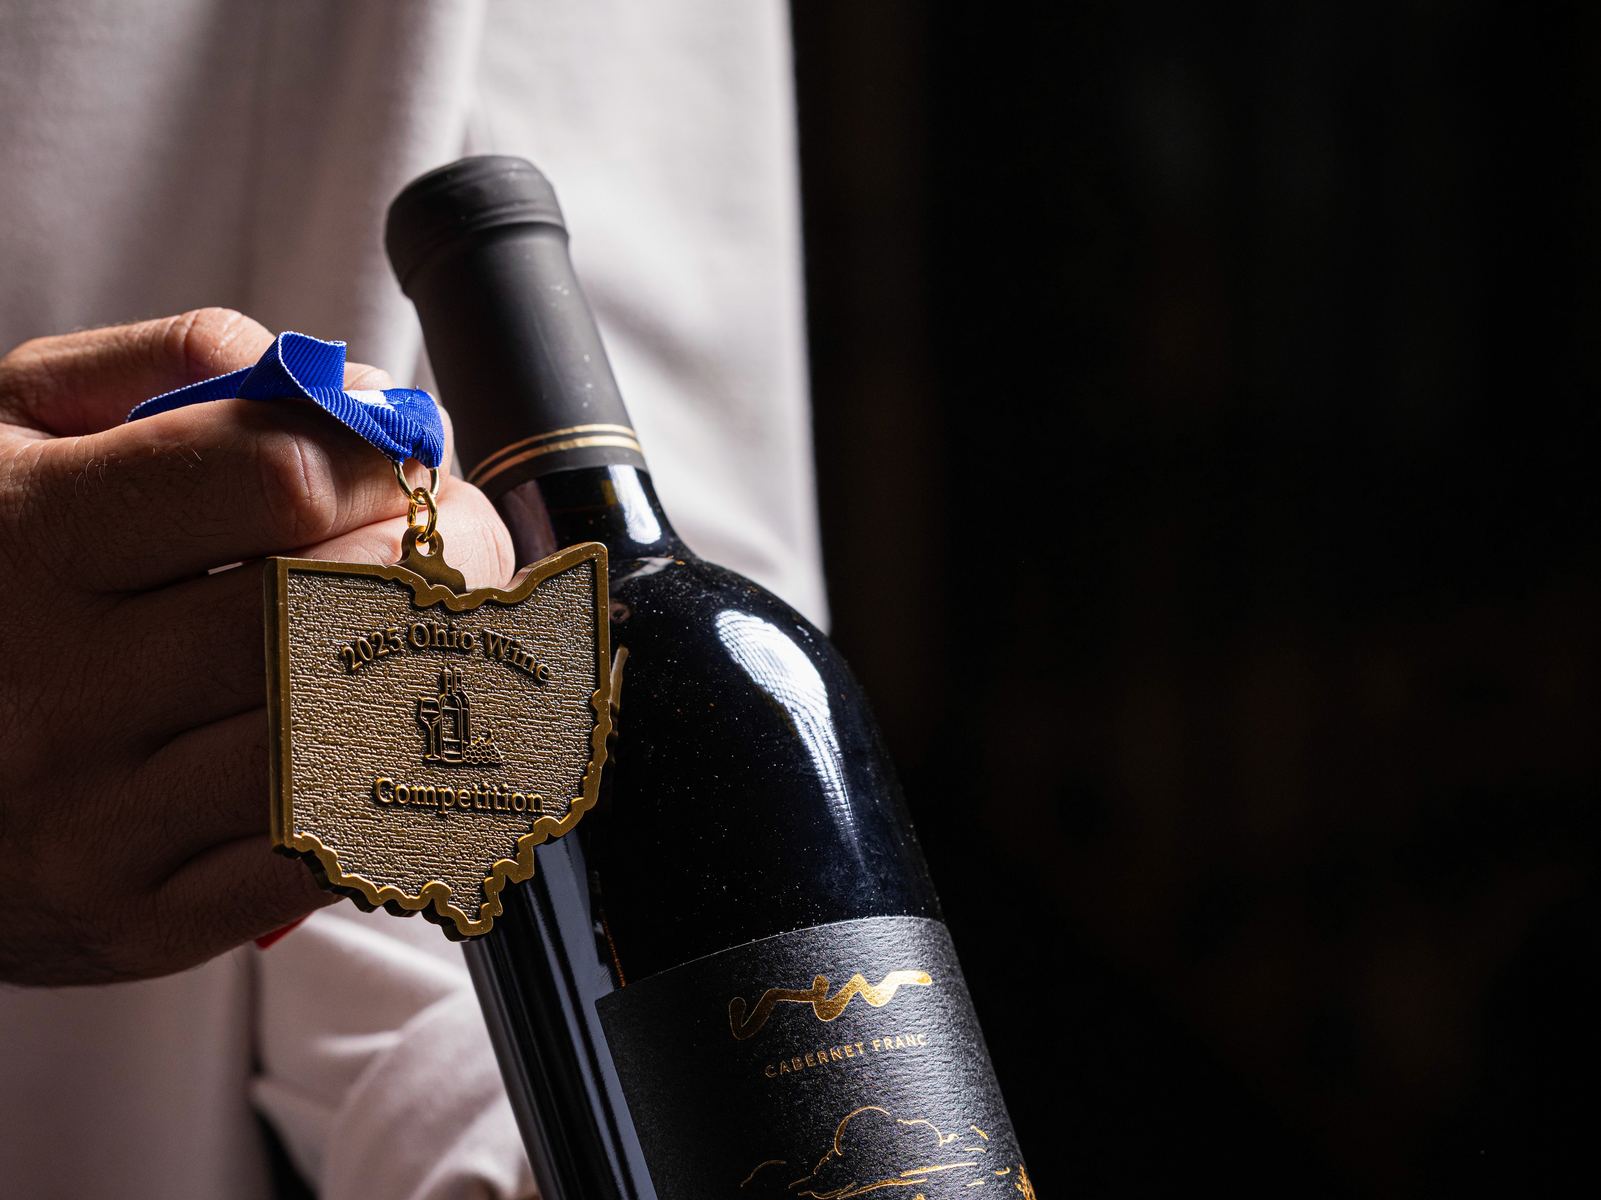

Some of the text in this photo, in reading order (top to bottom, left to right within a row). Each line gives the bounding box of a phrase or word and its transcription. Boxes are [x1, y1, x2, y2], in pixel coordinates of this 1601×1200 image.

[342, 622, 550, 682] 2025 Ohio Wine
[374, 776, 544, 815] Competition
[764, 1033, 927, 1079] CABERNET FRANC
